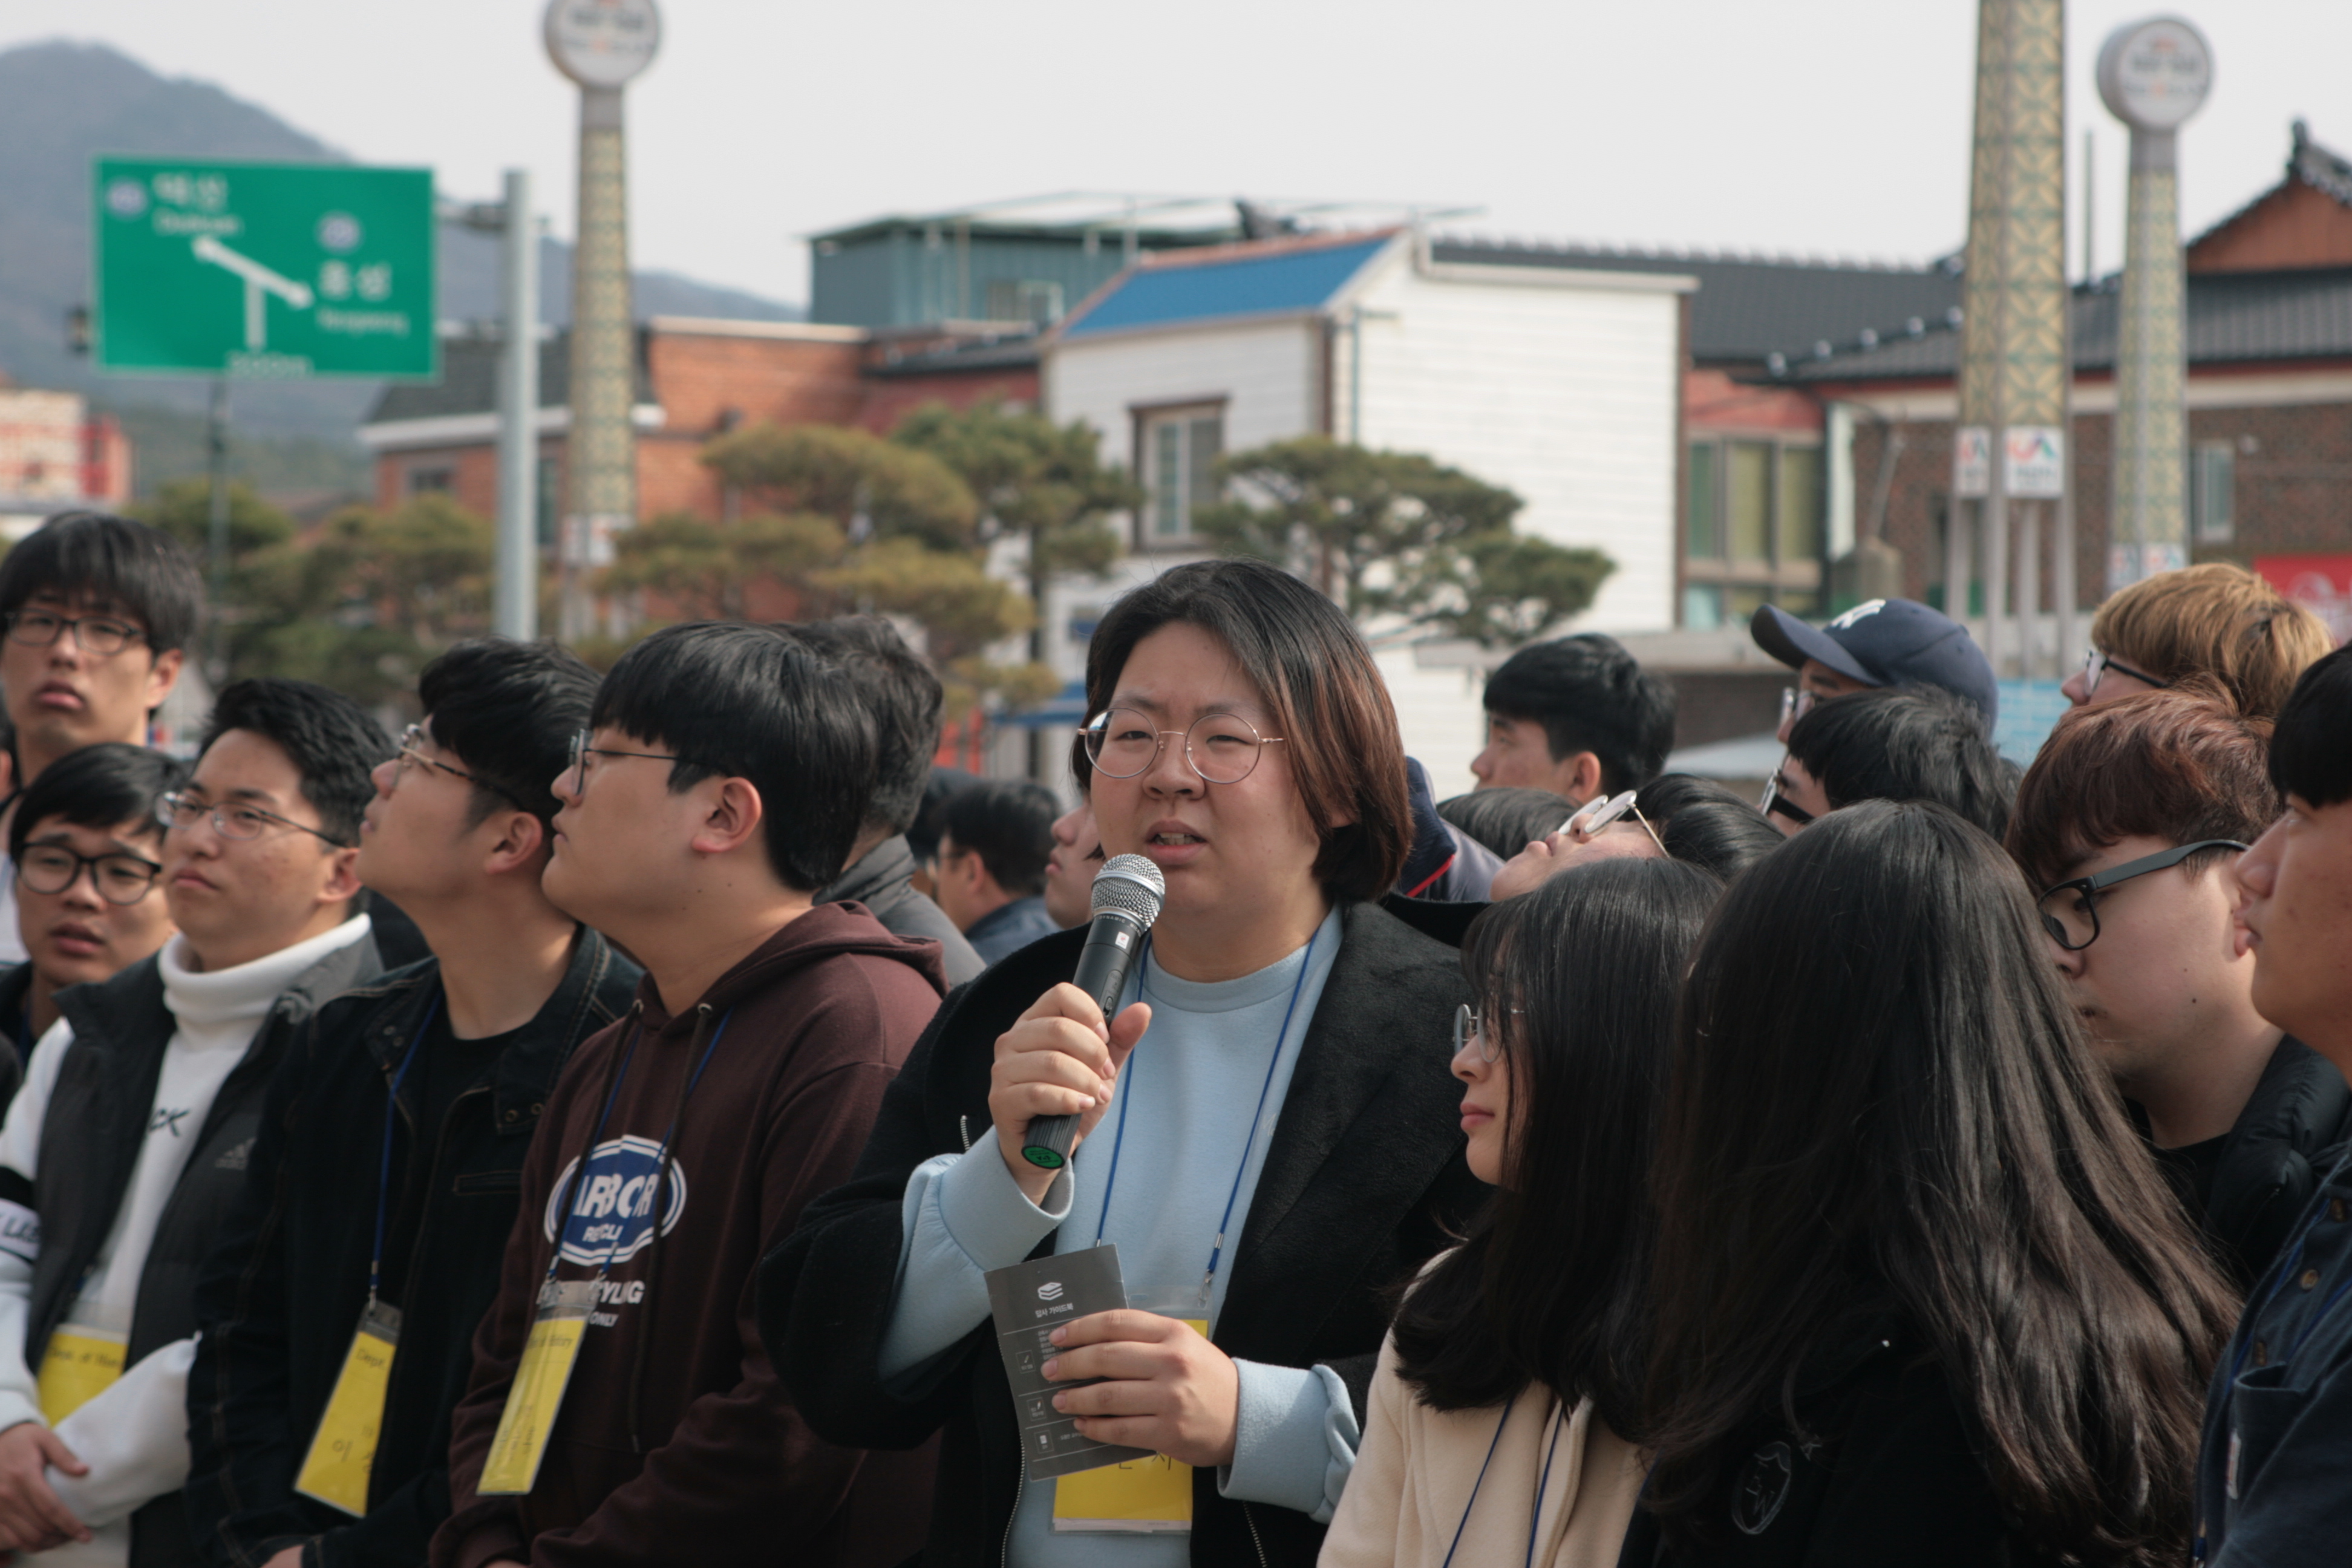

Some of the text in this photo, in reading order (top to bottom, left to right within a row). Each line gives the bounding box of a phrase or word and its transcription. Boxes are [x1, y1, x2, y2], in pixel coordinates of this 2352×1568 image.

[1098, 915, 1126, 924] DYNAMIC
[1035, 1302, 1074, 1318] 답사 가이드북
[589, 1311, 619, 1328] ONLY
